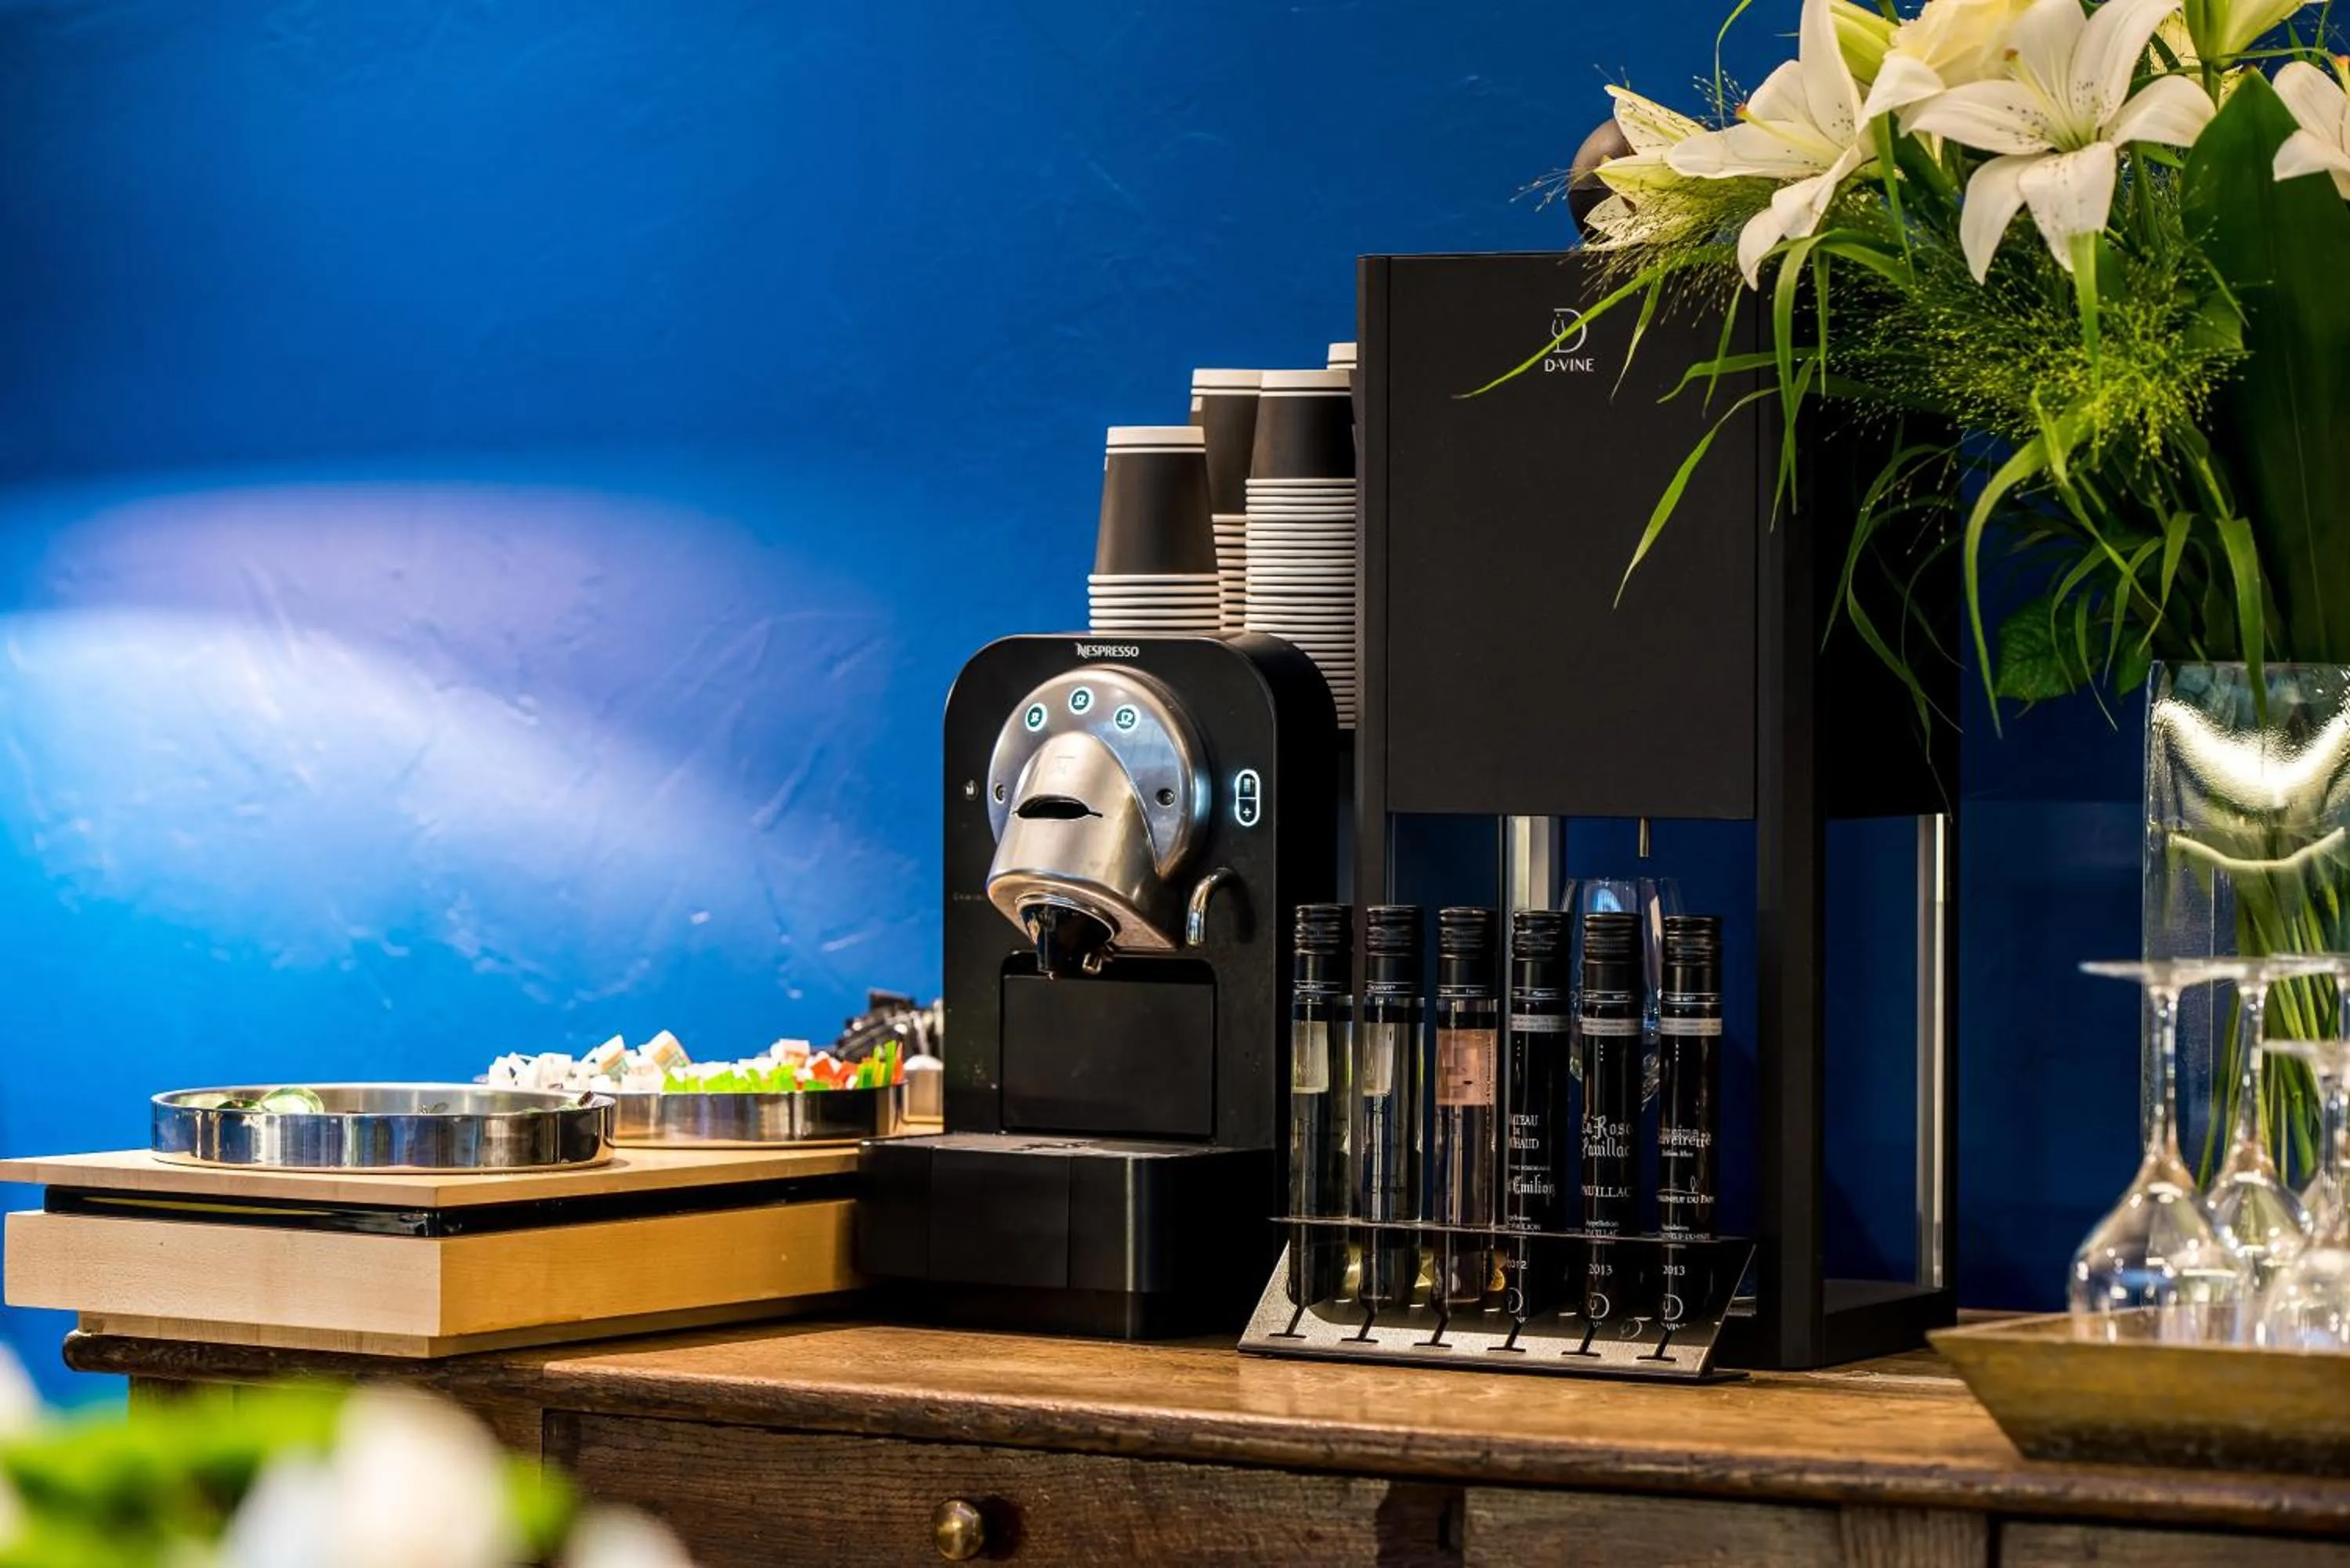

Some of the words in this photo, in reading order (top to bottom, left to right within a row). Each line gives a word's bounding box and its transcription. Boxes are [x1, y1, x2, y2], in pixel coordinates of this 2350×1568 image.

[1075, 642, 1139, 659] NESPRESSO
[1589, 1263, 1614, 1277] 2013
[1663, 1265, 1686, 1277] 2013
